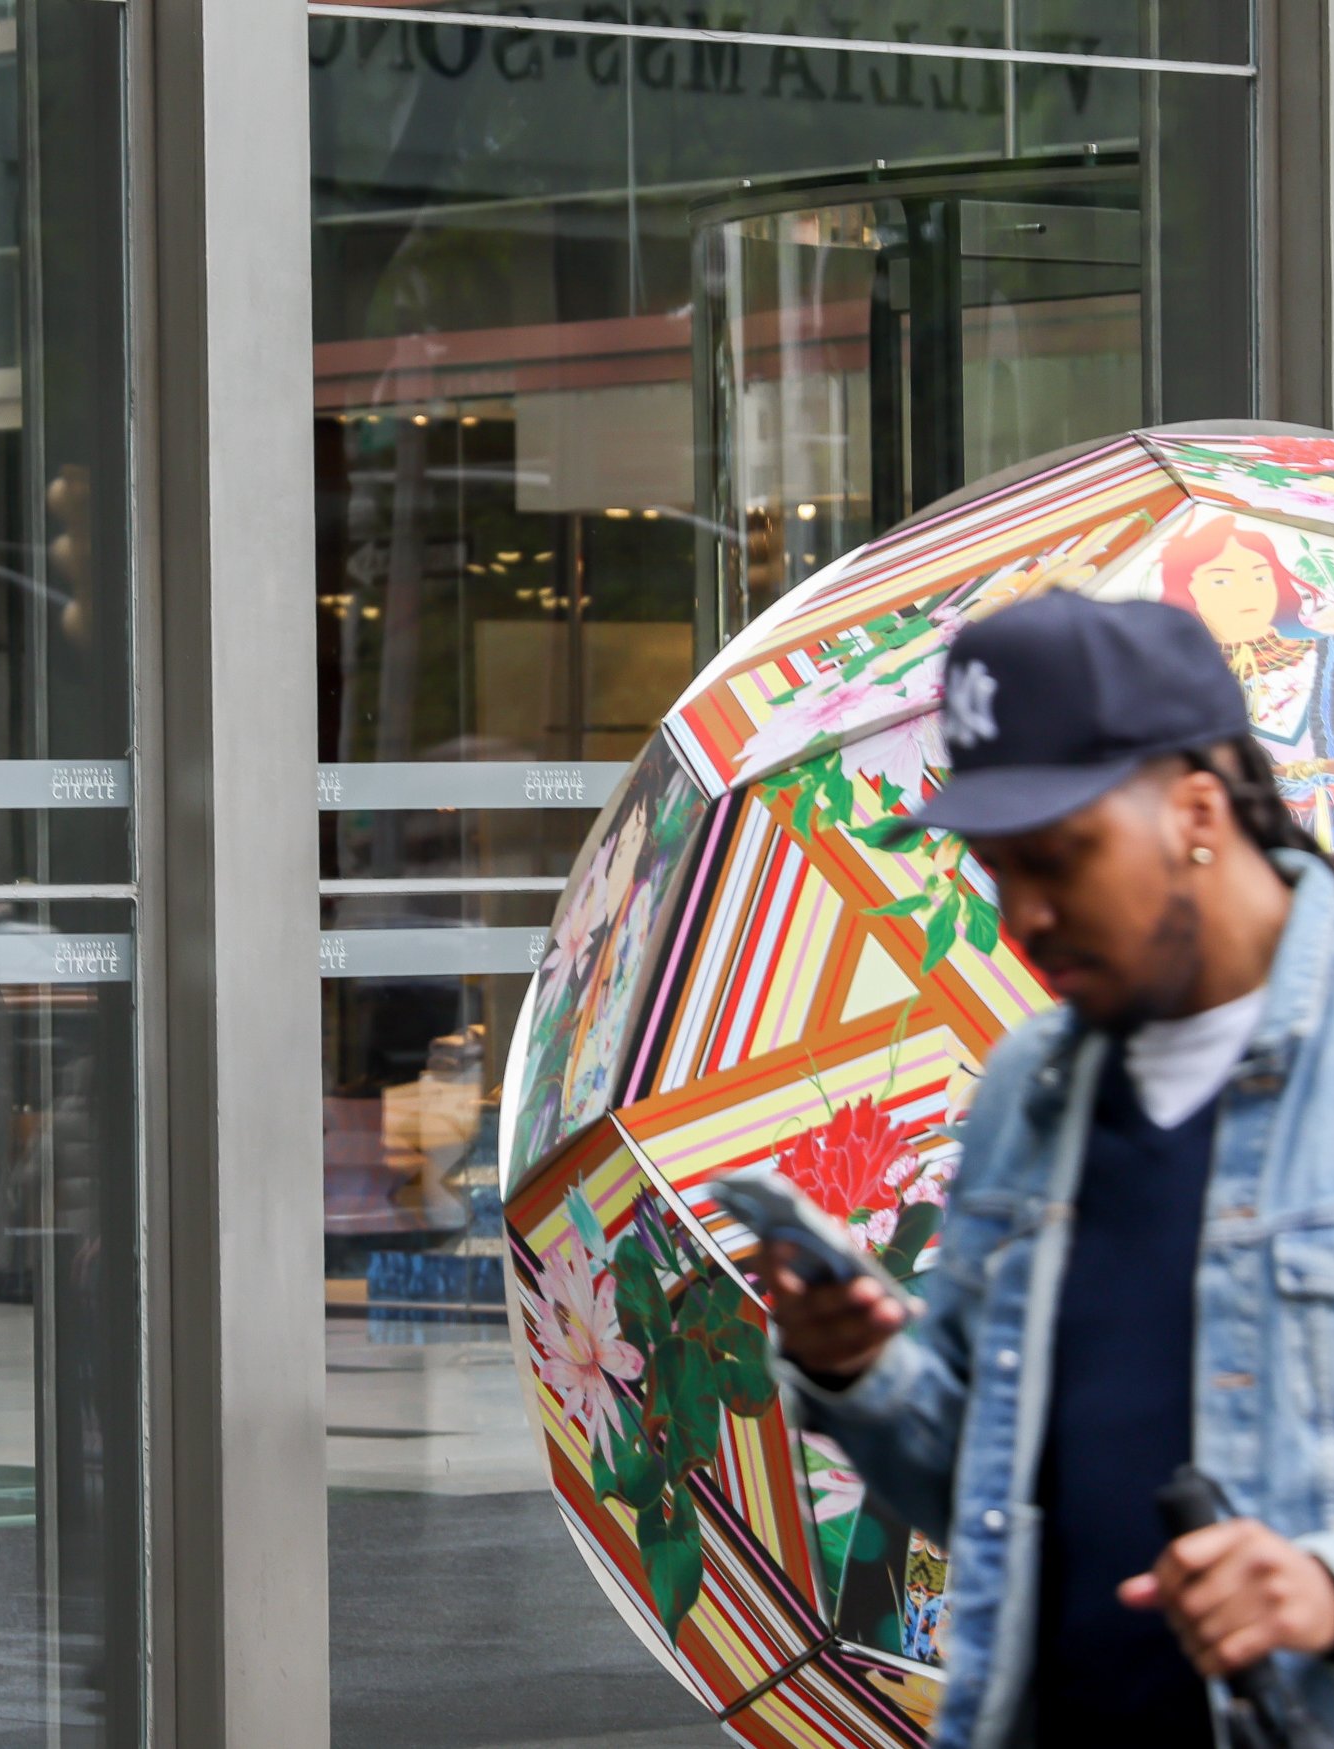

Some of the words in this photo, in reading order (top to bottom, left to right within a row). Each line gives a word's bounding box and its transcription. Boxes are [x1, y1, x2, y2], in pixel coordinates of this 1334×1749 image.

[52, 776, 115, 787] COLUMBUS
[525, 777, 583, 788] COLUMBUS
[52, 785, 115, 799] CIRCLE
[525, 786, 583, 800] CIRCLE
[55, 949, 117, 961] COLUMBUS
[55, 958, 117, 974] CIRCLE
